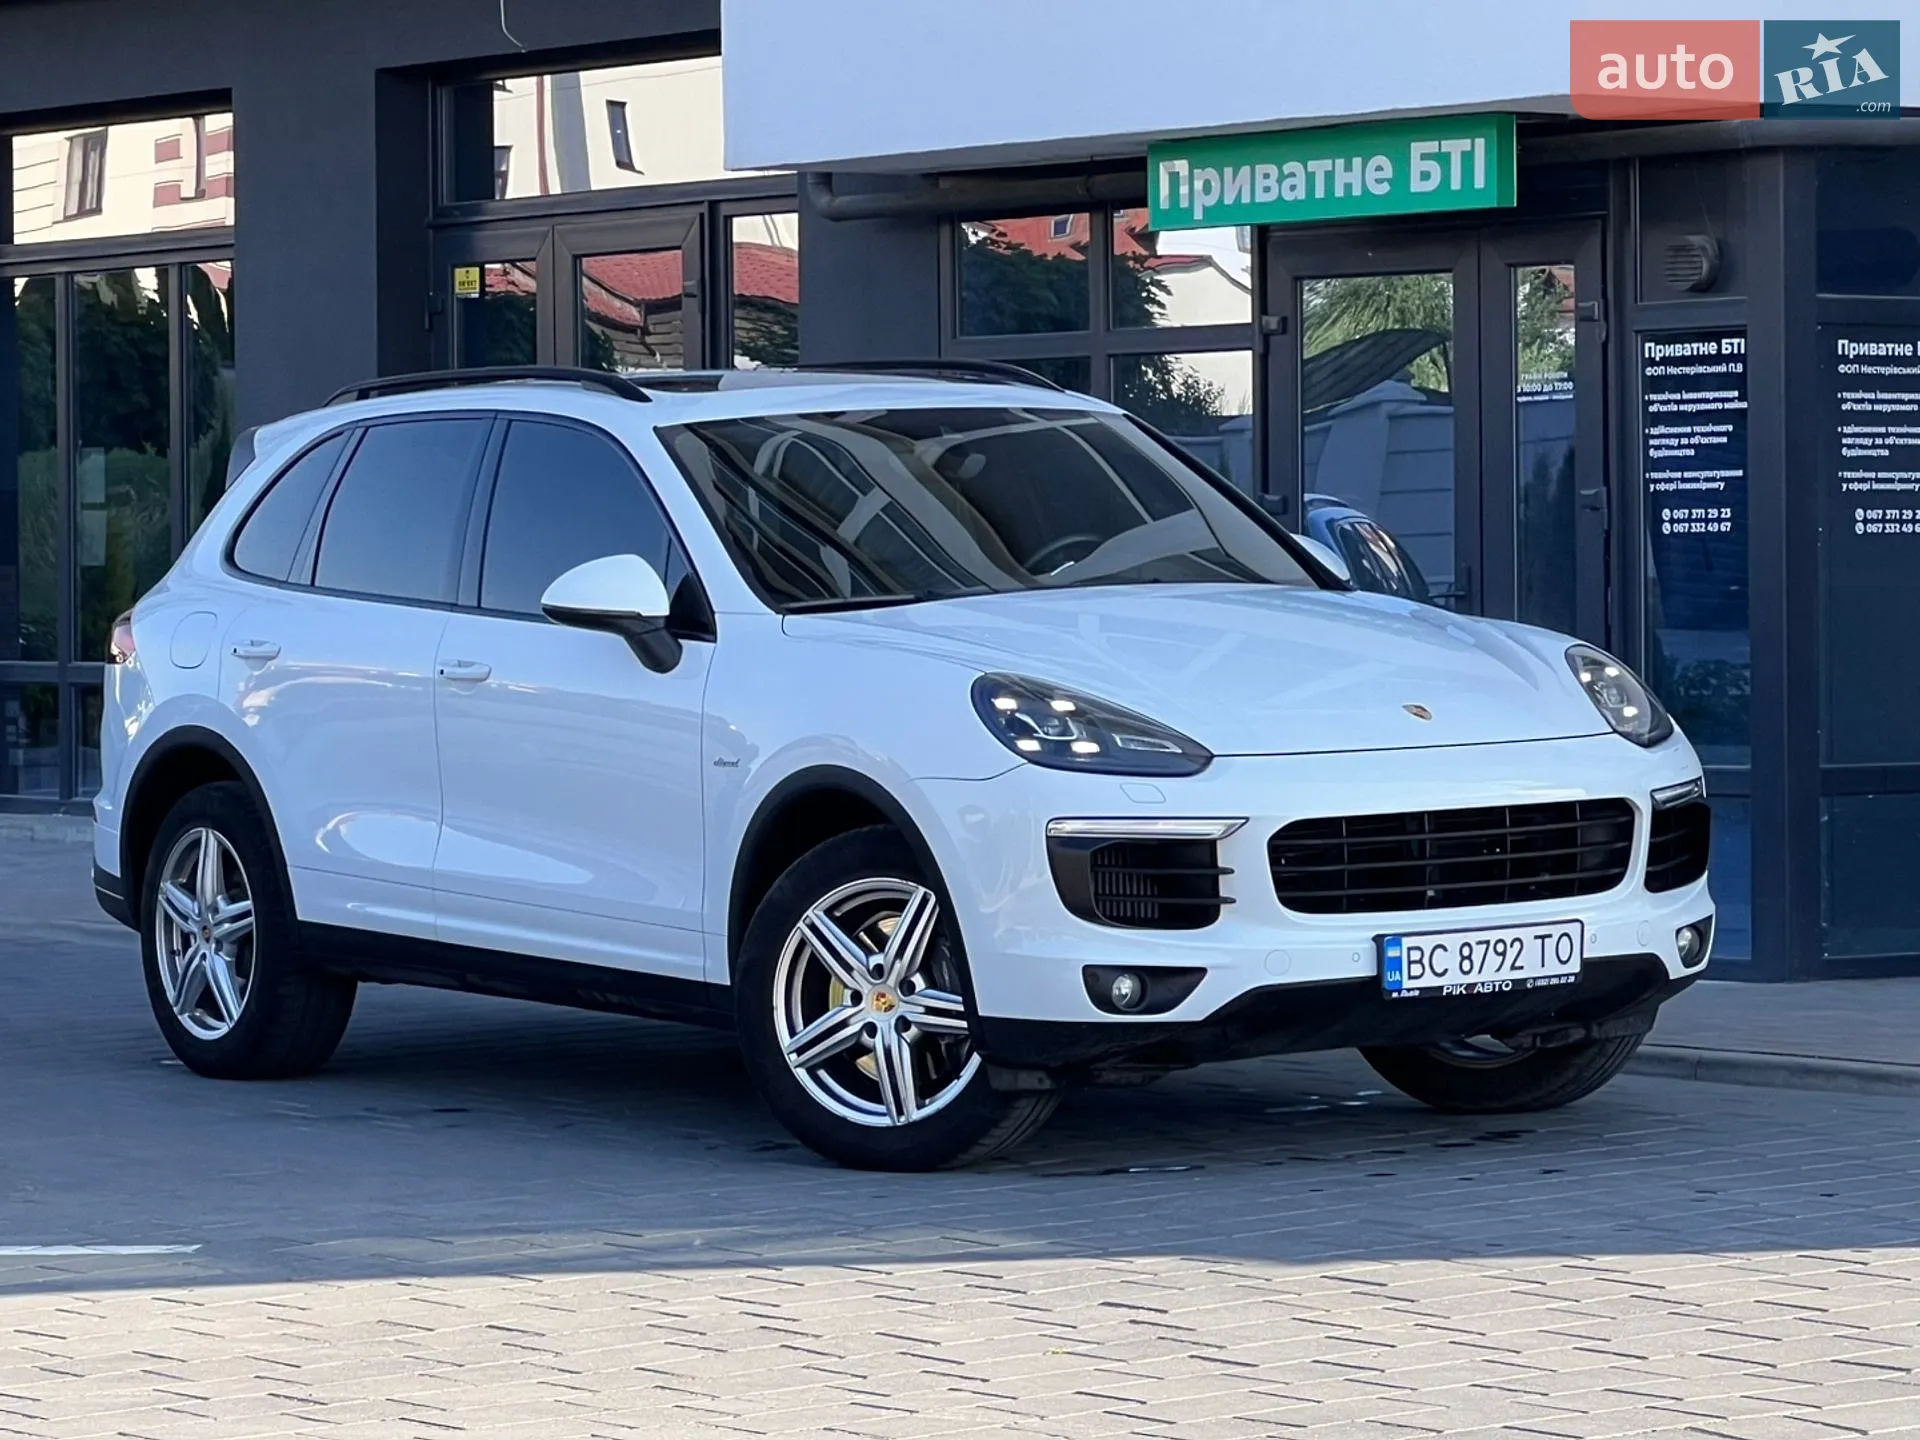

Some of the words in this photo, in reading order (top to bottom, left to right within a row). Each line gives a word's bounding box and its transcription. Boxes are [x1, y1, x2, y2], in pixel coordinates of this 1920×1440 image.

[1159, 154, 1394, 220] Приватне
[1410, 137, 1486, 193] БТІ
[1644, 342, 1718, 361] Приватне
[1721, 338, 1745, 354] БТІ
[1838, 339, 1913, 359] Приватне
[1645, 365, 1665, 376] ФОП
[1838, 364, 1860, 374] ФОП
[1672, 509, 1689, 519] 067
[1866, 509, 1883, 520] 067
[1672, 522, 1689, 533] 067
[1707, 521, 1719, 532] 49
[1720, 521, 1731, 532] 67
[1866, 522, 1883, 533] 067
[1901, 522, 1914, 533] 49
[1406, 943, 1449, 981] BC
[1458, 937, 1524, 976] 8792
[1387, 971, 1401, 982] UA
[1473, 980, 1512, 994] АВТО
